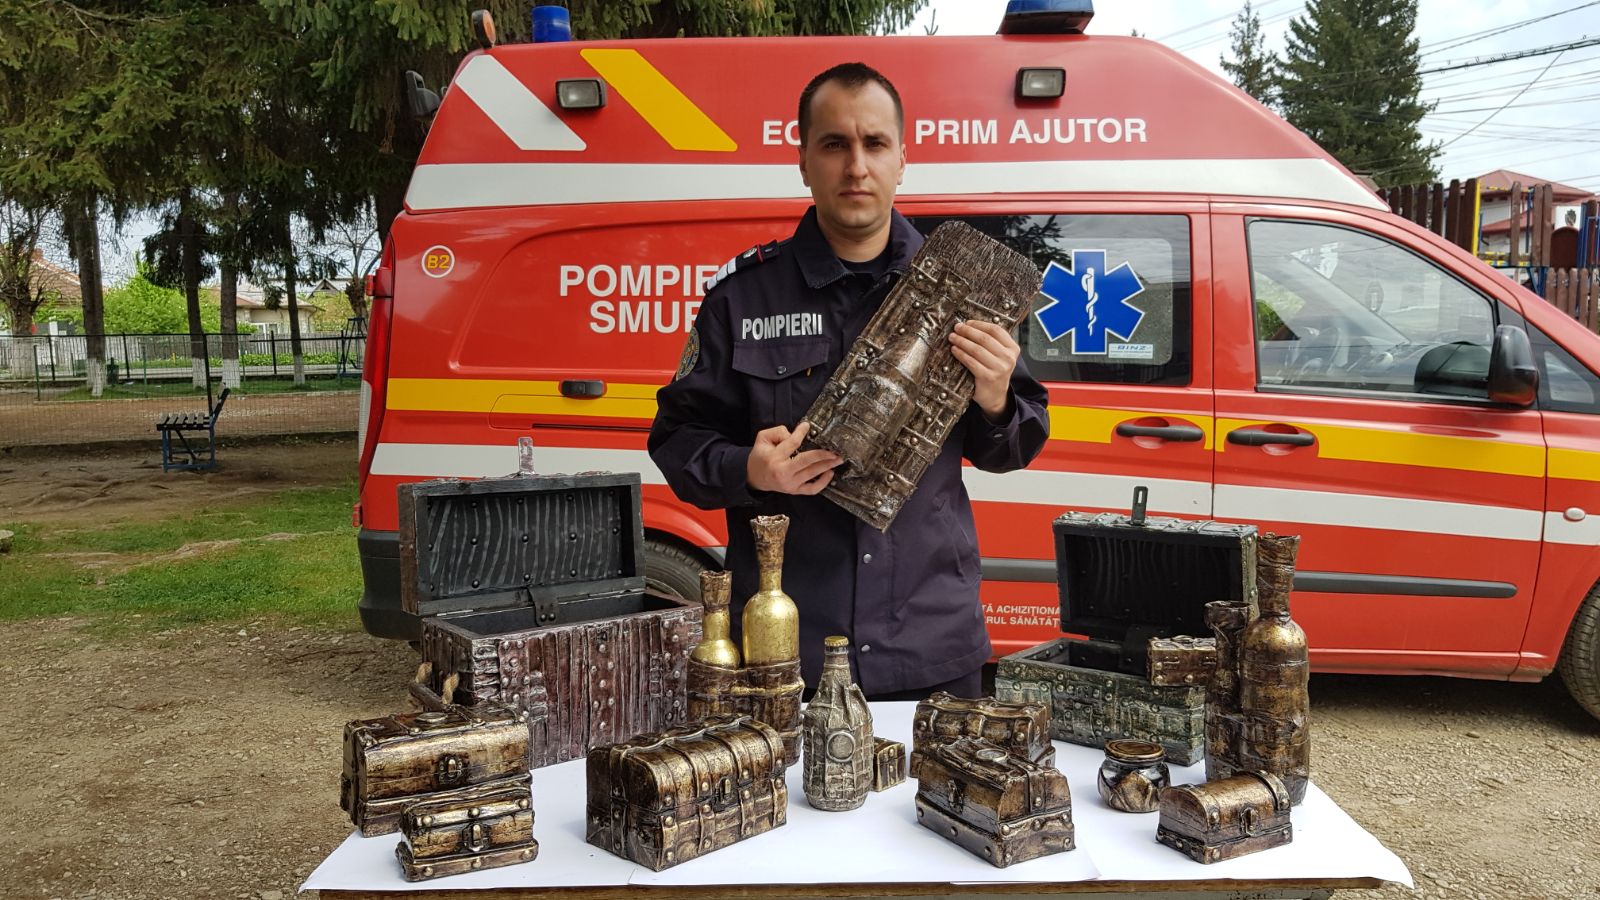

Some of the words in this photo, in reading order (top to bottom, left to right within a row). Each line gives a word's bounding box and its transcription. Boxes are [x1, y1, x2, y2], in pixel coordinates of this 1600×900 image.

[915, 119, 998, 145] PRIM
[1008, 117, 1147, 144] AJUTOR
[427, 254, 450, 269] B2
[742, 312, 823, 340] POMPIERII
